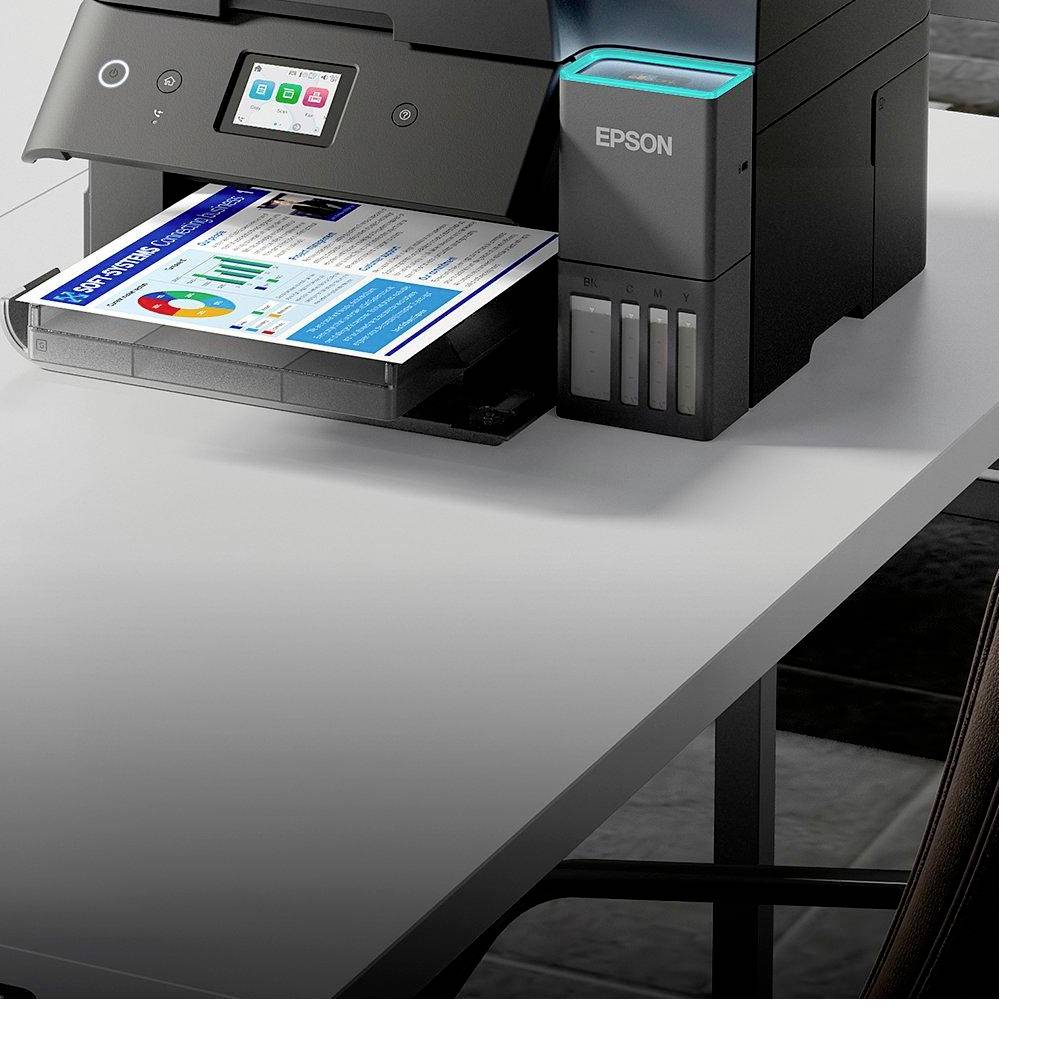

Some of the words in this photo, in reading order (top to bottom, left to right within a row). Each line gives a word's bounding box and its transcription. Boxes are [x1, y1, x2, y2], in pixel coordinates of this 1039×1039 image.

[596, 127, 672, 156] EPSON
[70, 245, 162, 294] SOFT-SYSTEMS
[147, 216, 214, 248] Connecting
[584, 277, 599, 290] BK
[653, 289, 663, 300] M
[682, 293, 691, 303] Y
